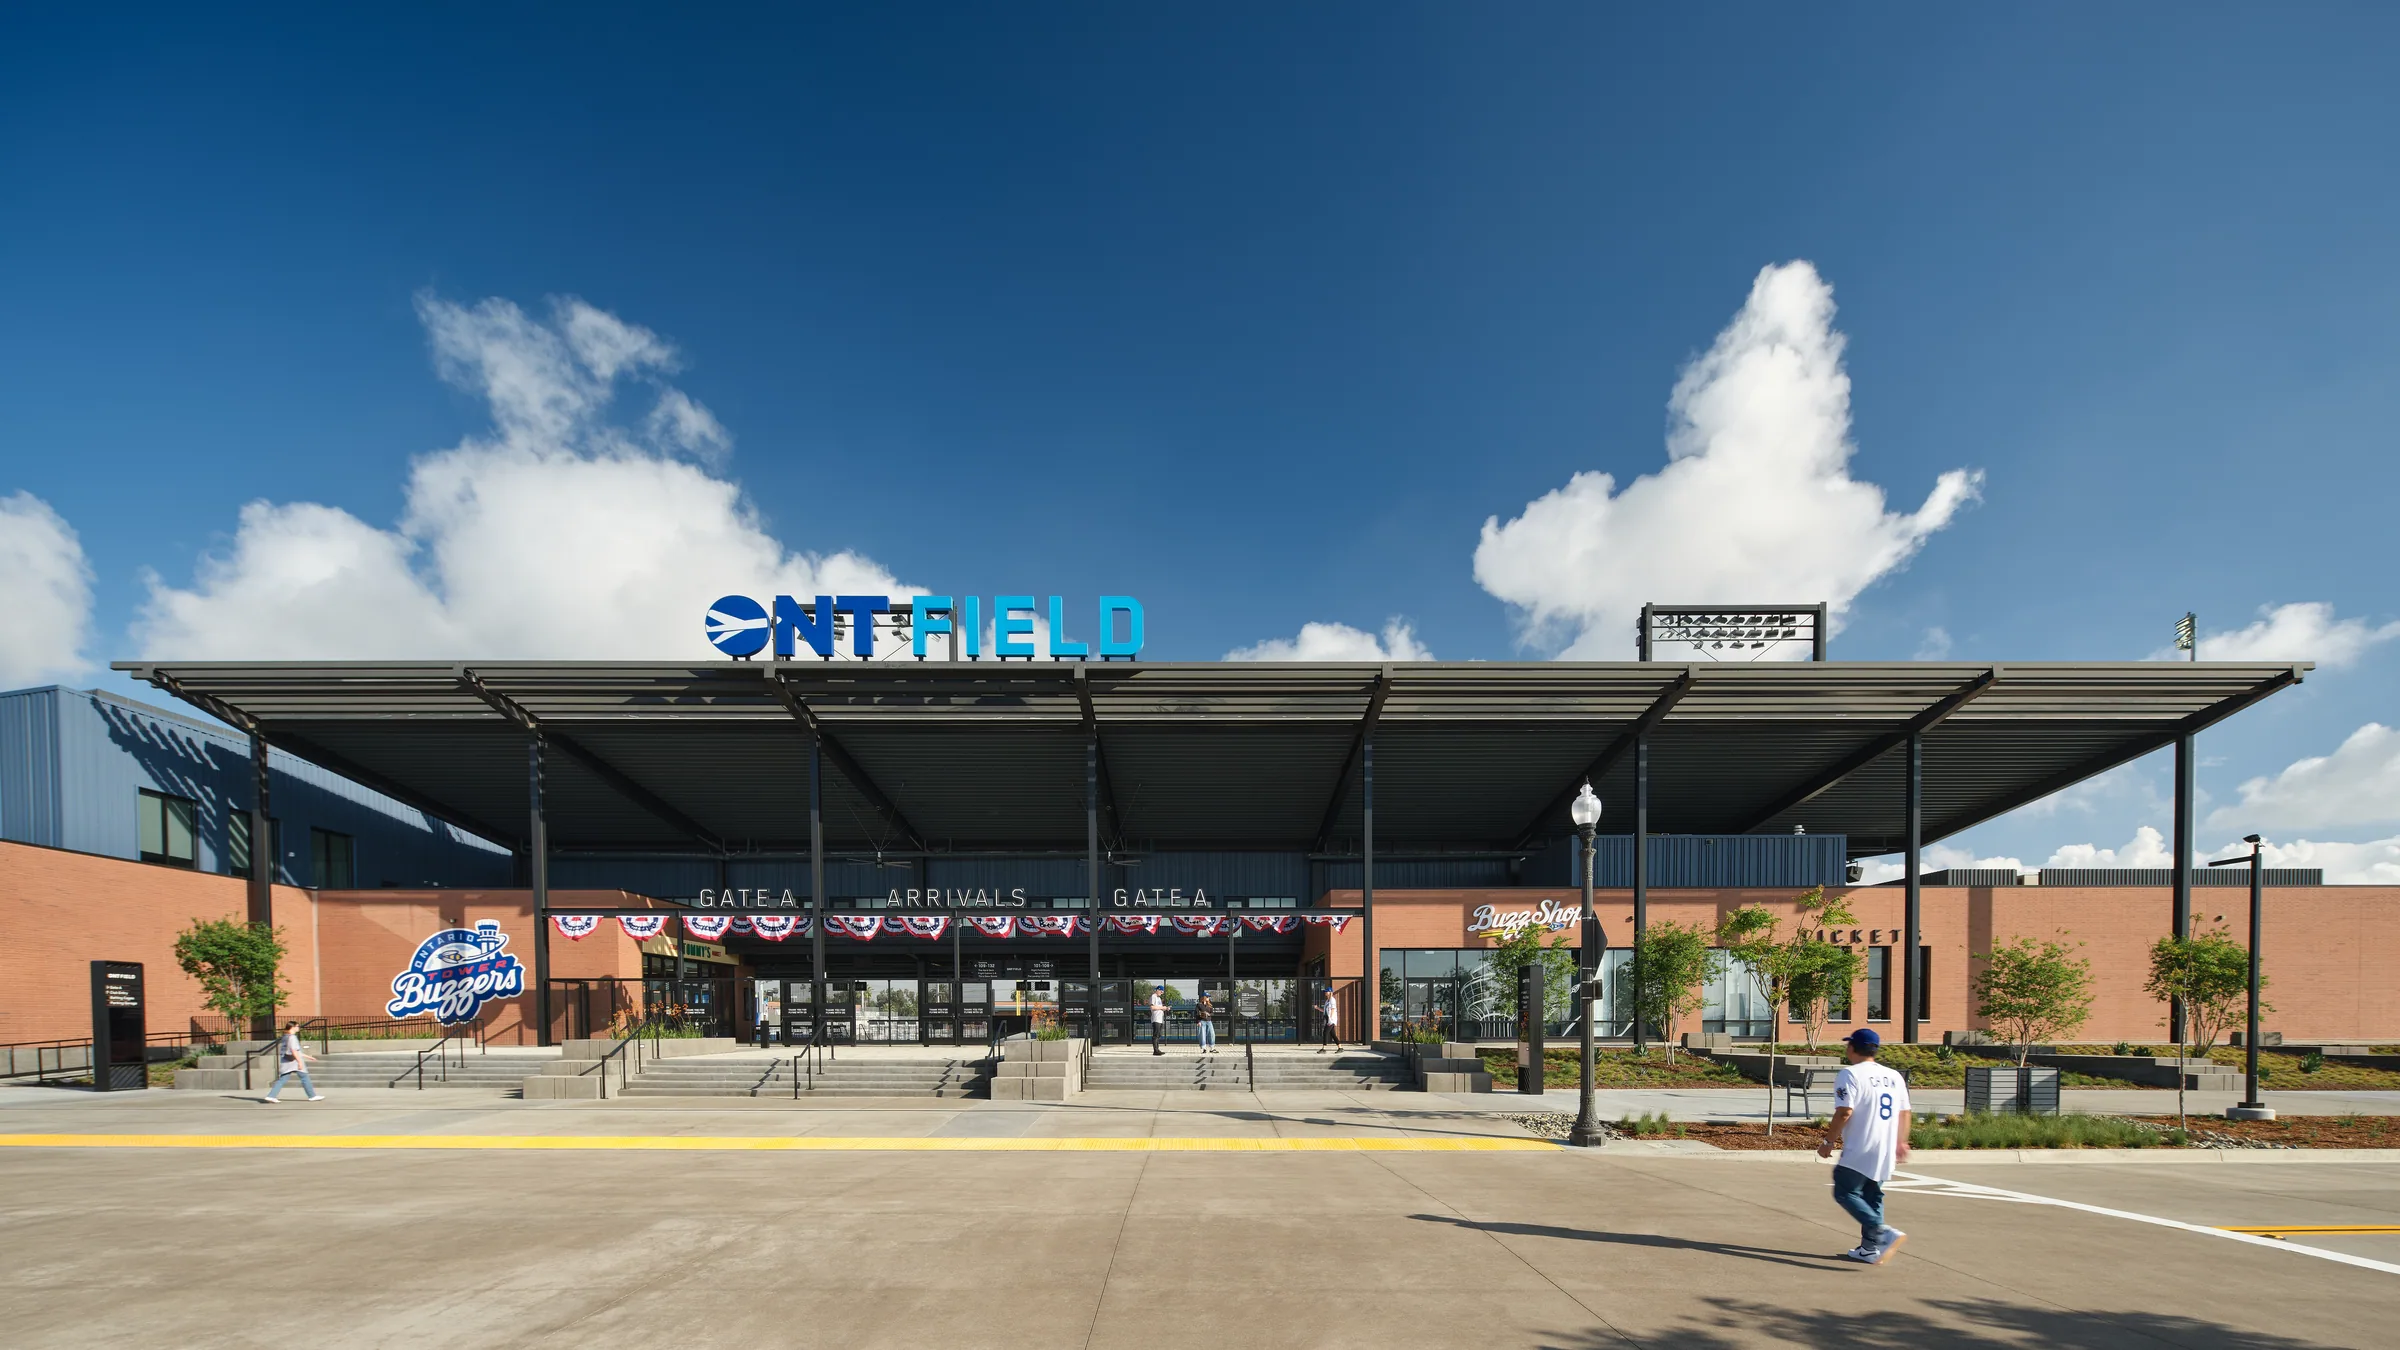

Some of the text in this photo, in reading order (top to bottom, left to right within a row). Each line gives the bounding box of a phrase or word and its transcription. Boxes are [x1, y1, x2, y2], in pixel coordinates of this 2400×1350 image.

[704, 594, 1144, 657] ONT FIELD
[700, 888, 796, 907] GATE A
[886, 888, 1025, 907] ARRIVALS
[1114, 888, 1207, 907] GATE A
[1467, 899, 1582, 940] Buzz Shop
[414, 933, 475, 969] ONTARIO
[427, 960, 508, 981] TOWER
[390, 968, 517, 1018] Buzzers
[1880, 1093, 1892, 1120] 8
